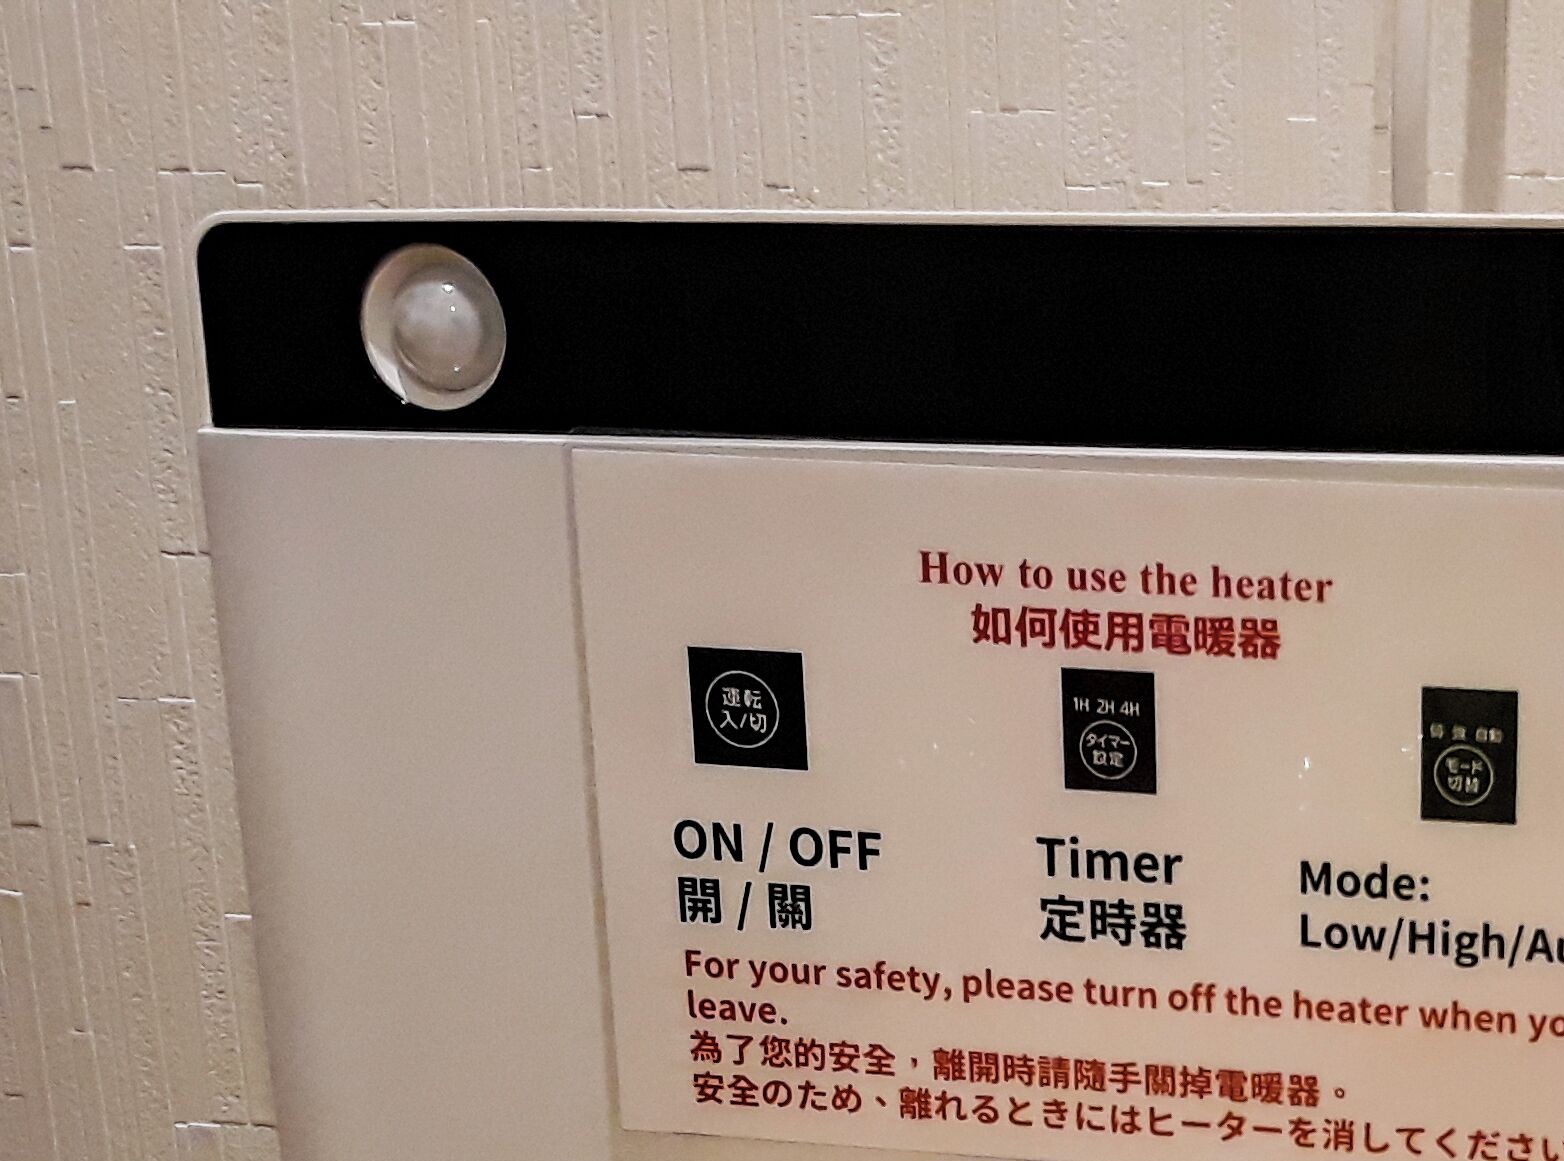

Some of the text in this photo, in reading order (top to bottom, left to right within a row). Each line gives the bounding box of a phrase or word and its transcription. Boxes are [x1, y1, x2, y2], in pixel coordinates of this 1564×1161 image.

[919, 550, 1334, 603] How to use the heater
[972, 603, 1281, 660] 如何使用電暖器
[720, 709, 767, 733] 入/切
[673, 820, 743, 863] ON
[789, 827, 882, 871] OFF
[1036, 836, 1183, 885] Timer
[1300, 861, 1430, 902] Mode:
[1039, 893, 1187, 950] 定時器
[684, 949, 741, 980] For
[749, 959, 827, 988] your
[836, 961, 953, 1002] safety,
[963, 968, 1075, 1004] please
[1083, 978, 1157, 1009] turn
[1167, 982, 1219, 1015] off
[1224, 986, 1283, 1018] the
[1293, 990, 1410, 1027] heater
[1418, 1001, 1517, 1035] when
[687, 989, 789, 1025] leave.
